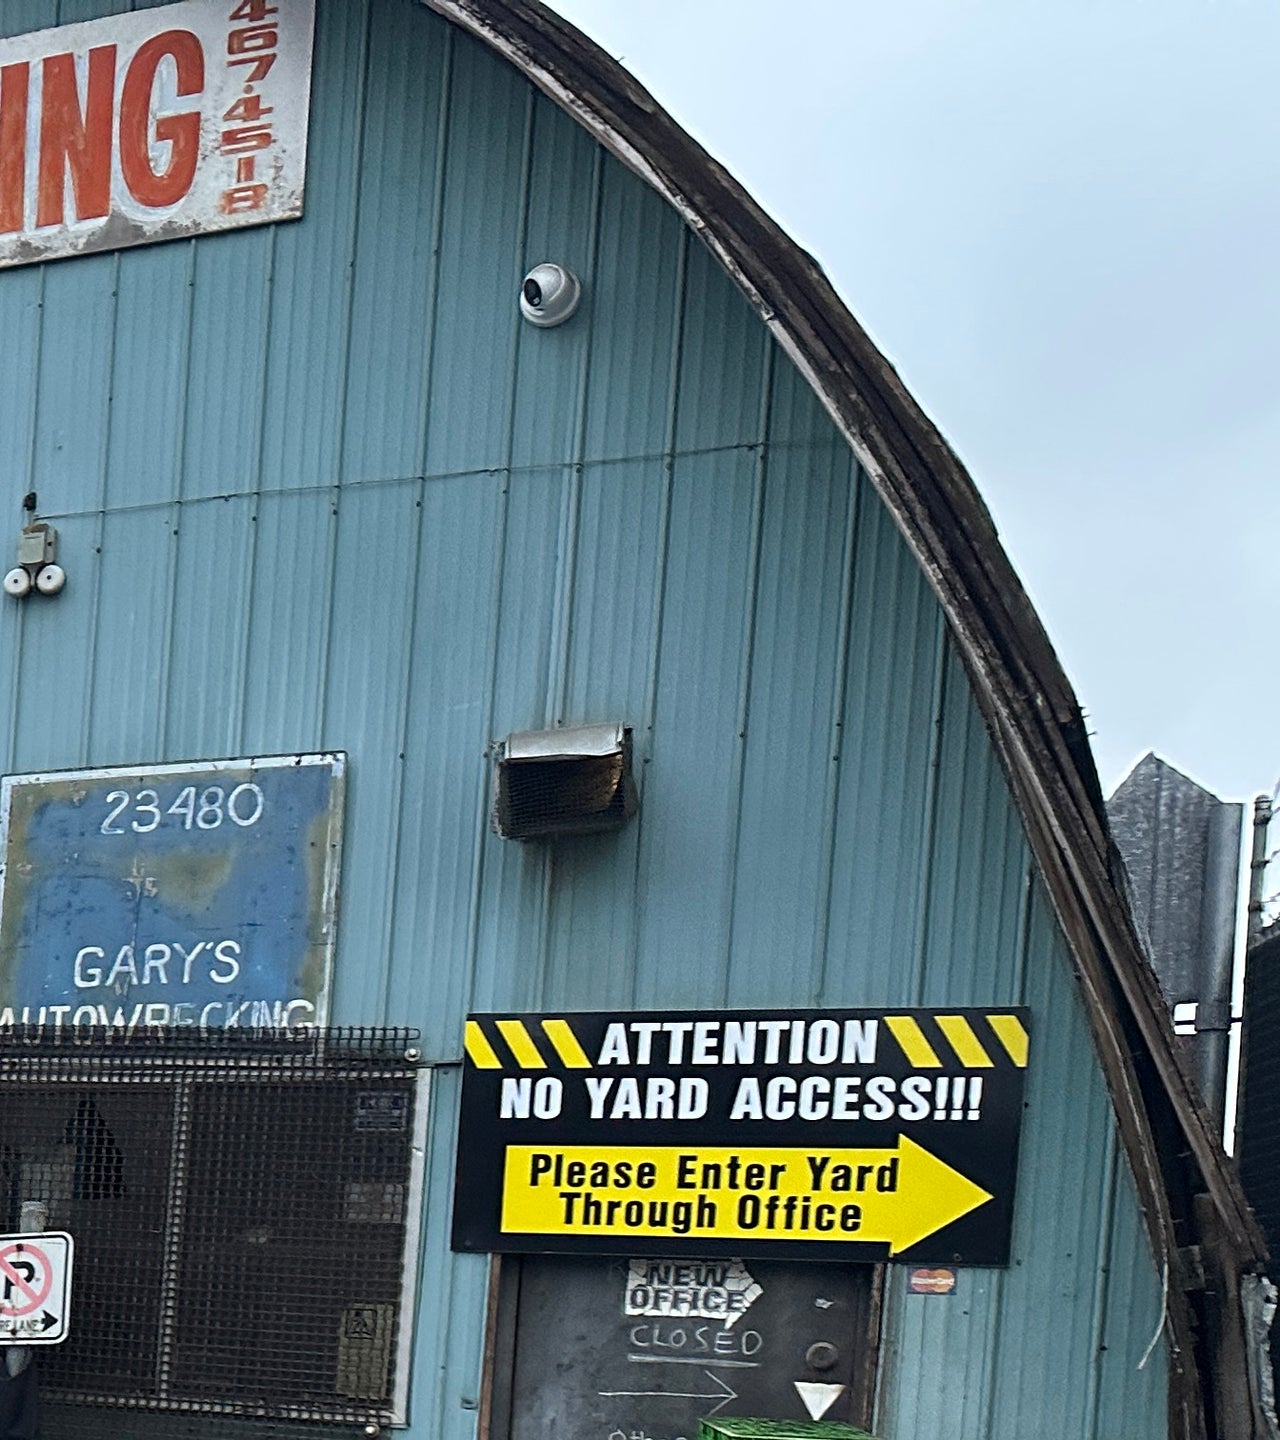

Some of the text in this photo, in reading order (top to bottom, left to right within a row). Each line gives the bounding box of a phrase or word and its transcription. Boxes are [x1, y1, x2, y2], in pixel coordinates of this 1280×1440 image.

[100, 782, 265, 835] 23480
[73, 940, 241, 988] GARY'S
[598, 1019, 879, 1066] ATTENTION
[499, 1075, 984, 1122] NO YARD ACCESS!!!
[529, 1152, 899, 1193] Please Enter Yard
[559, 1190, 862, 1234] Through Office
[648, 1263, 726, 1287] NEW
[631, 1284, 746, 1313] OFFICE
[630, 1323, 763, 1355] CLOSED
